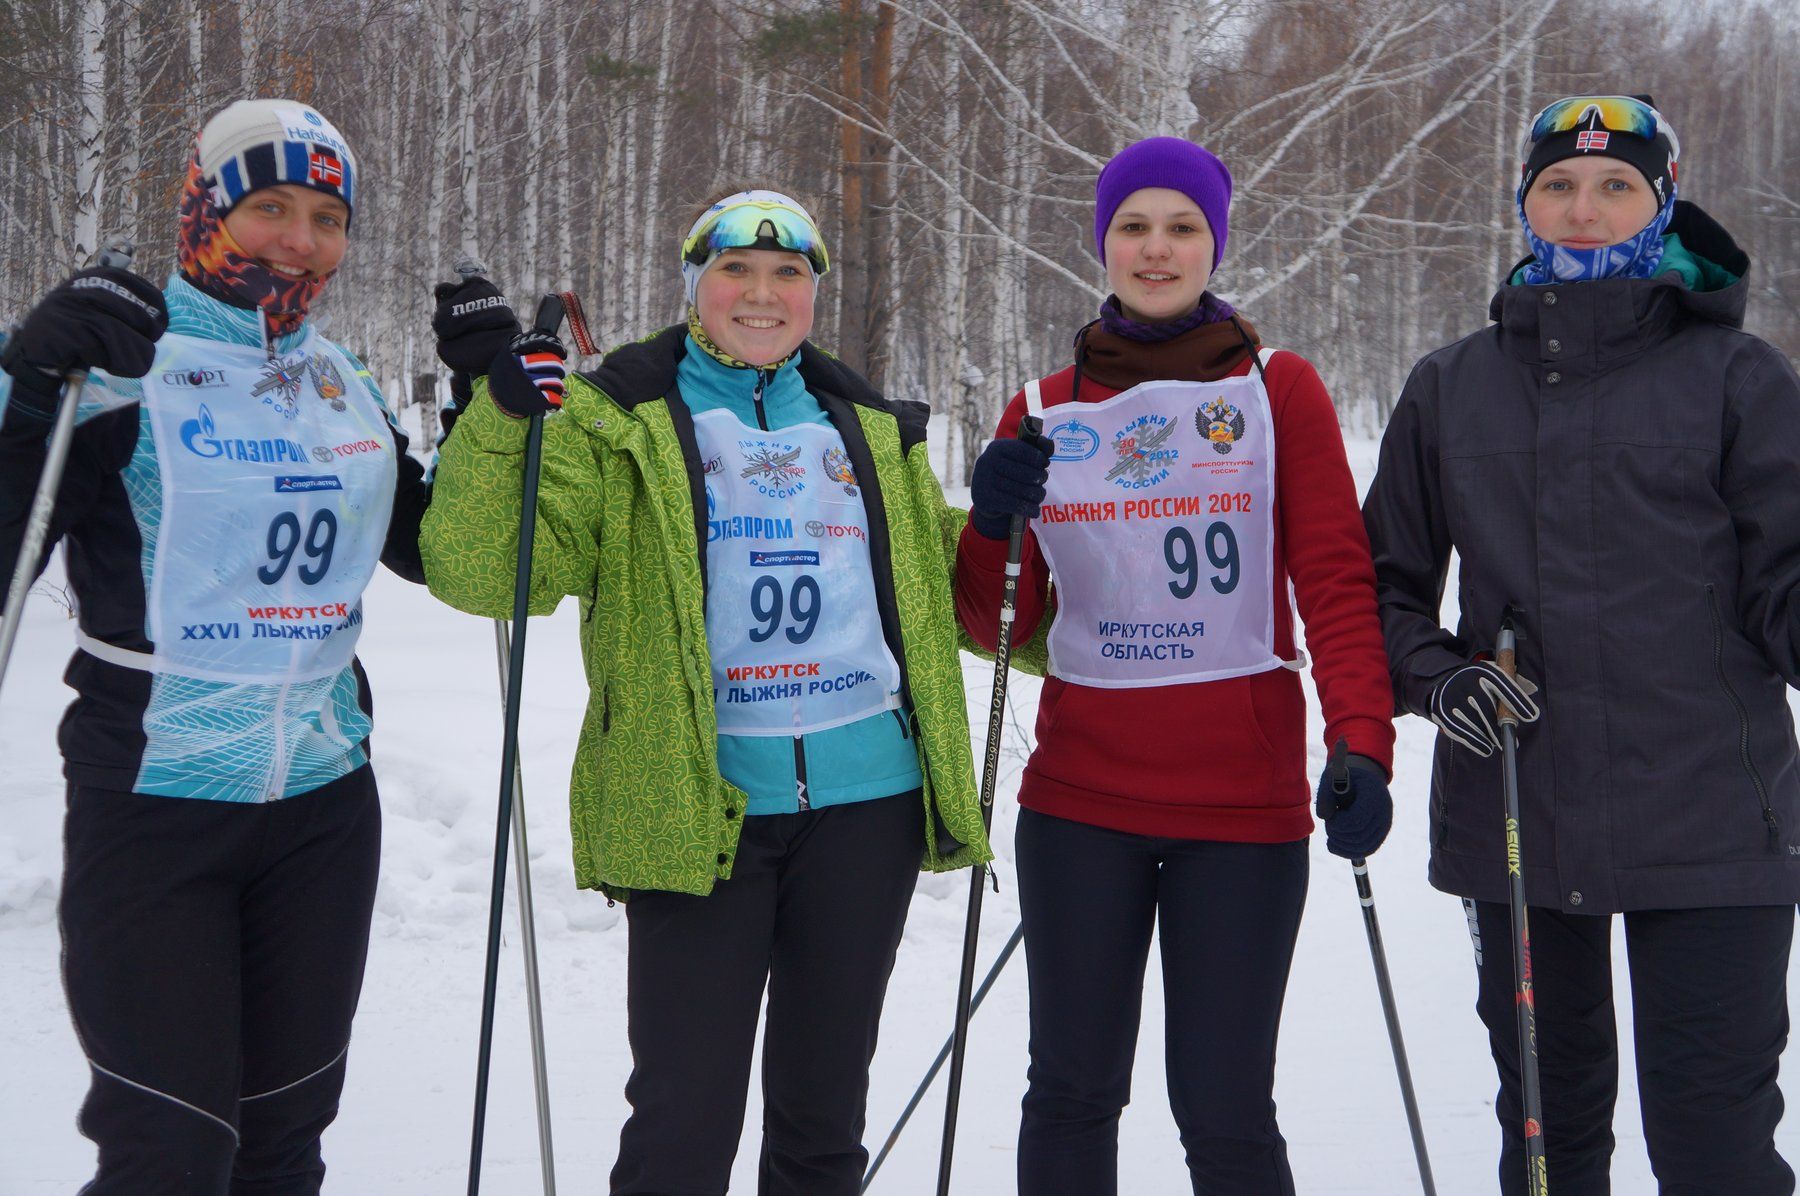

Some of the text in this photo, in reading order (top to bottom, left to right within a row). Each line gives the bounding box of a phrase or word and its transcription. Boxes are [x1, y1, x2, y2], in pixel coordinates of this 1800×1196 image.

[452, 296, 512, 316] nonam
[1115, 414, 1167, 440] ЛЫЖНЯ
[332, 440, 382, 457] TOYOTA
[737, 440, 793, 452] ЛЫЖНЯ
[1120, 438, 1136, 449] 30
[1149, 449, 1179, 461] 2012
[1115, 469, 1170, 490] РОССИИ
[749, 479, 806, 500] РОССИИ
[1041, 493, 1252, 524] ЛЫЖНЯ РОССИИ 2012
[721, 515, 794, 542] ГАЗПРОМ
[825, 525, 867, 544] TOYOTA
[256, 508, 338, 586] 99
[1163, 520, 1241, 600] 99
[246, 602, 348, 620] ИРКУТСК
[748, 574, 822, 645] 99
[180, 622, 333, 641] XXVI ЛЫЖНЯ
[1098, 621, 1205, 639] ИРКУТСКАЯ
[1100, 642, 1195, 661] ОБЛАСТЬ
[726, 663, 821, 682] ИРКУТСК
[726, 683, 802, 704] ЛЫЖНЯ
